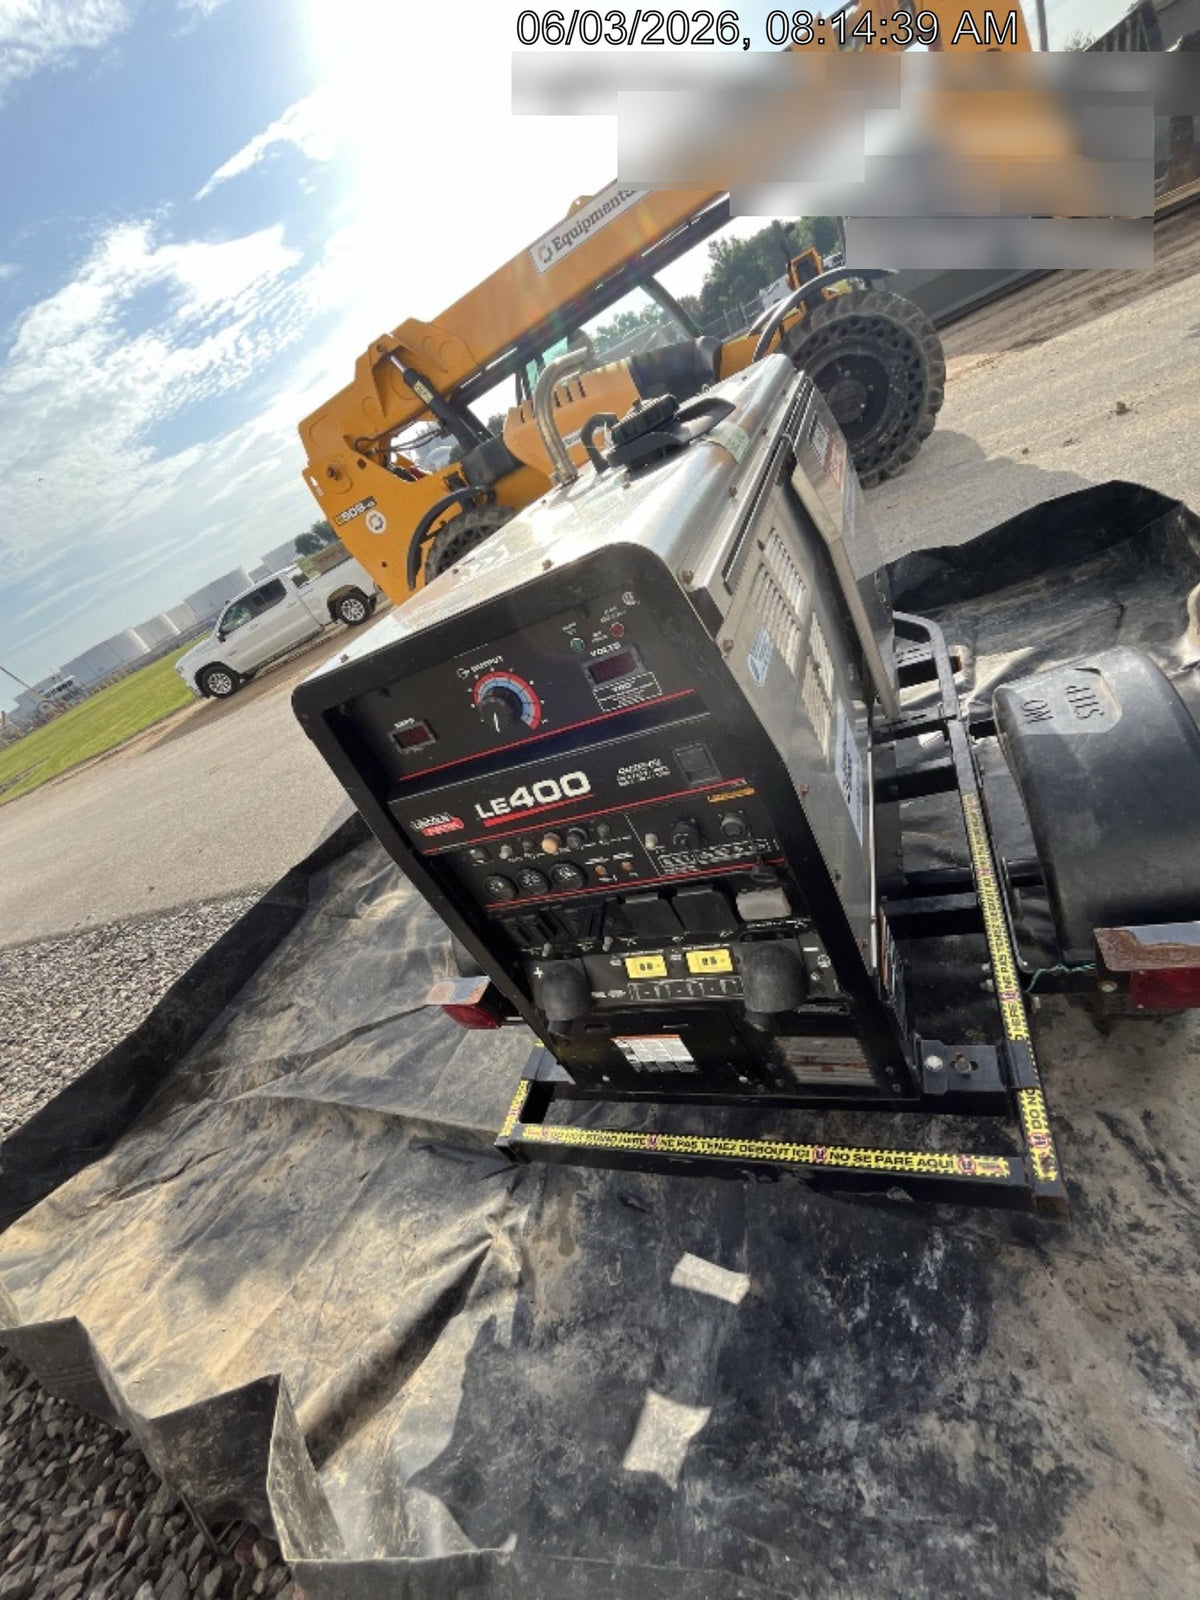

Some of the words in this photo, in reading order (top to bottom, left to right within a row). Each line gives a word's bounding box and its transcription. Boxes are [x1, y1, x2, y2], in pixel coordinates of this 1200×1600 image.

[474, 771, 591, 819] LE400
[1025, 1087, 1038, 1106] NO
[1029, 1109, 1043, 1129] DO
[829, 1150, 850, 1162] NO
[852, 1152, 872, 1164] SE
[874, 1155, 914, 1167] PARE
